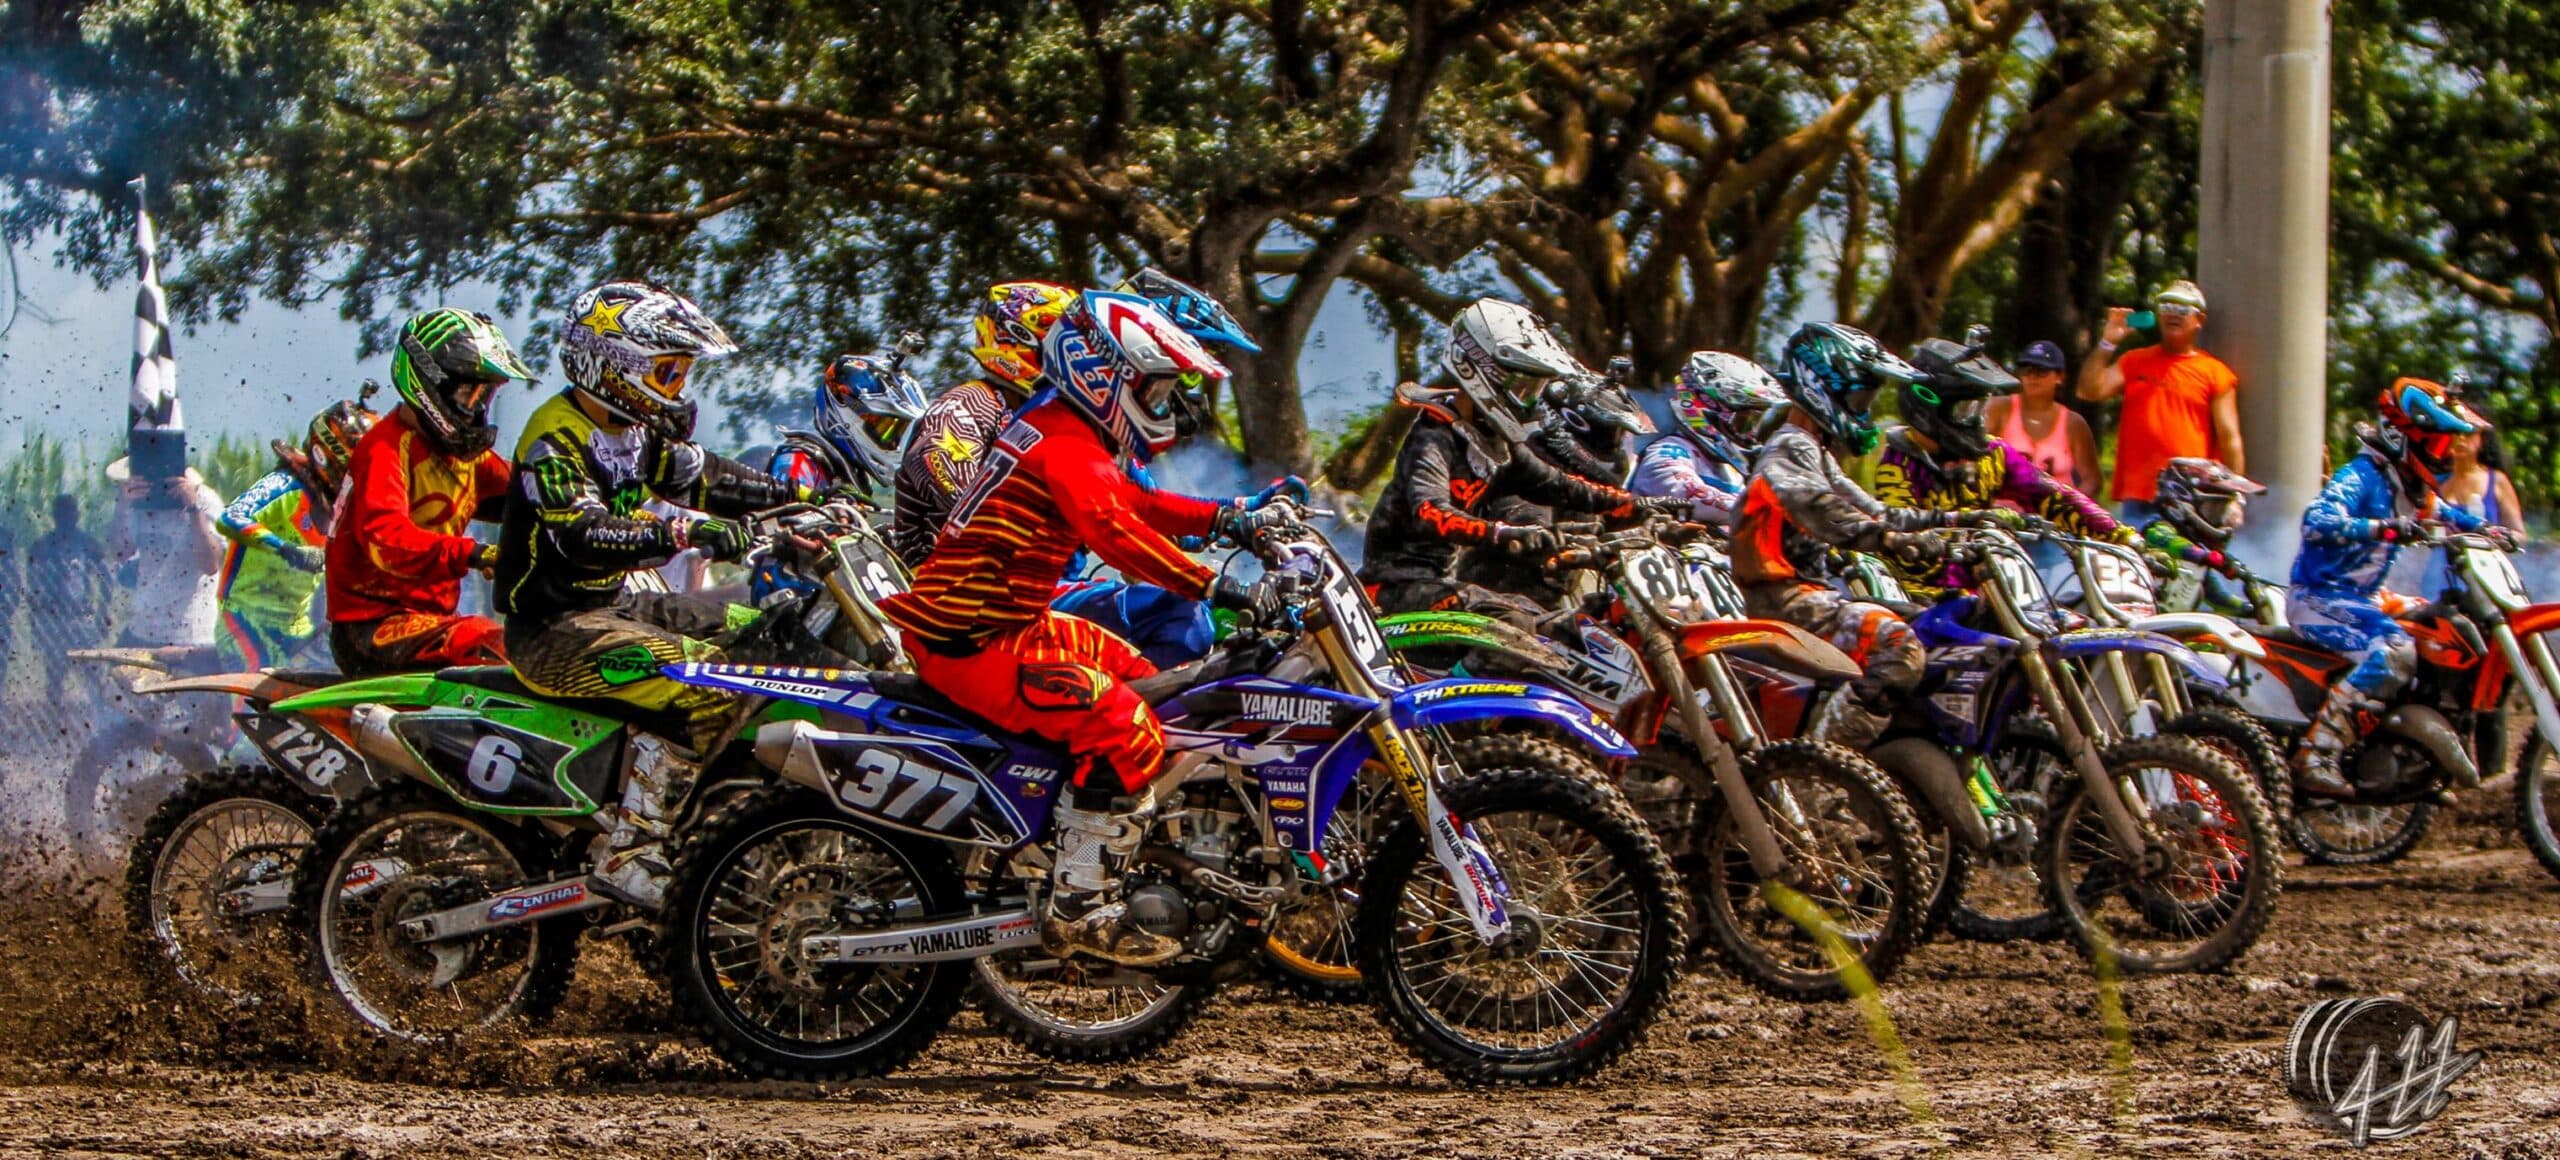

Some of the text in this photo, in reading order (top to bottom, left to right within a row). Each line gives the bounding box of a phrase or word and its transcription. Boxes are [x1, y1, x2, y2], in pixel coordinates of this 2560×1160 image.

[752, 680, 828, 696] DUNLOP
[1413, 684, 1529, 705] PHXTREME
[1240, 692, 1333, 726] YAMALUBE
[266, 717, 347, 787] 728
[467, 735, 523, 794] 6
[840, 748, 980, 831] 377
[1266, 780, 1307, 793] YAMAHA
[1434, 816, 1466, 863] YAMALUBE
[1464, 864, 1496, 913] BRAKING
[850, 925, 995, 958] GYTR YAMALUBE
